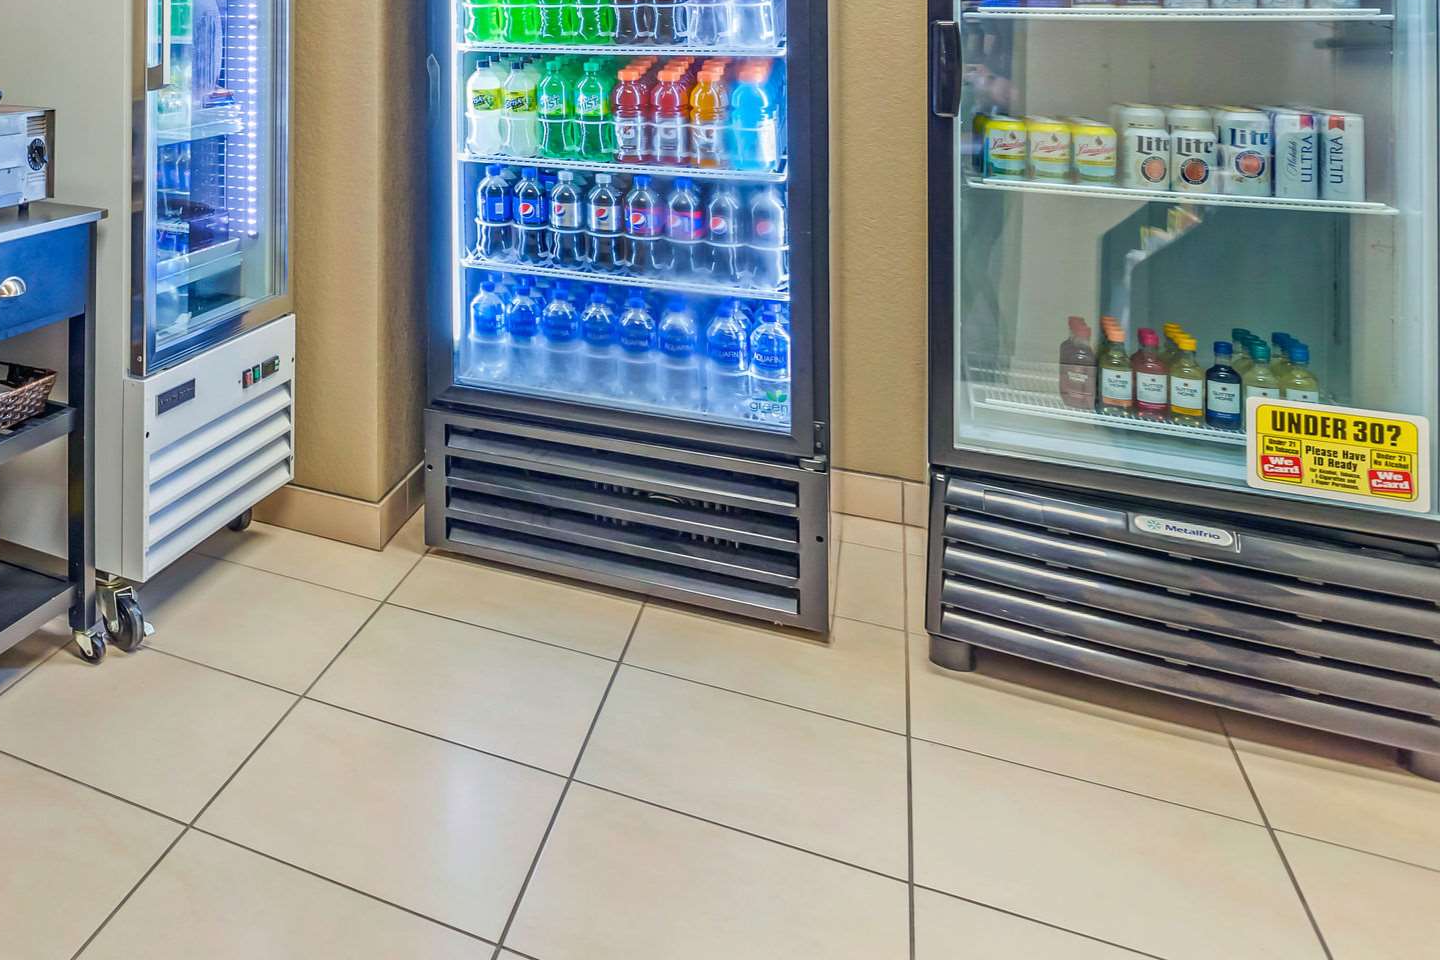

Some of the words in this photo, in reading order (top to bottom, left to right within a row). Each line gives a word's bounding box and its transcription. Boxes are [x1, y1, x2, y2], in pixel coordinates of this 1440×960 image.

[1136, 134, 1169, 156] Lite
[1229, 127, 1269, 148] Lite
[1177, 136, 1213, 157] Lite
[1300, 134, 1313, 183] ULTRA
[1329, 136, 1344, 184] ULTRA
[1271, 410, 1348, 441] UNDER
[1352, 420, 1402, 447] 30?
[1265, 444, 1274, 452] No
[1274, 445, 1300, 455] Tobacco
[1268, 437, 1287, 446] Under
[1288, 440, 1296, 448] 21
[1268, 456, 1294, 466] We
[1305, 445, 1338, 458] Please
[1342, 450, 1366, 462] Have
[1376, 452, 1397, 461] Under
[1263, 463, 1300, 474] Card
[1313, 456, 1324, 466] ID
[1327, 459, 1358, 472] Ready
[1383, 460, 1409, 470] Alcohol
[1371, 478, 1411, 490] Card
[1376, 471, 1403, 482] We
[1165, 524, 1220, 540] Metalfrio
